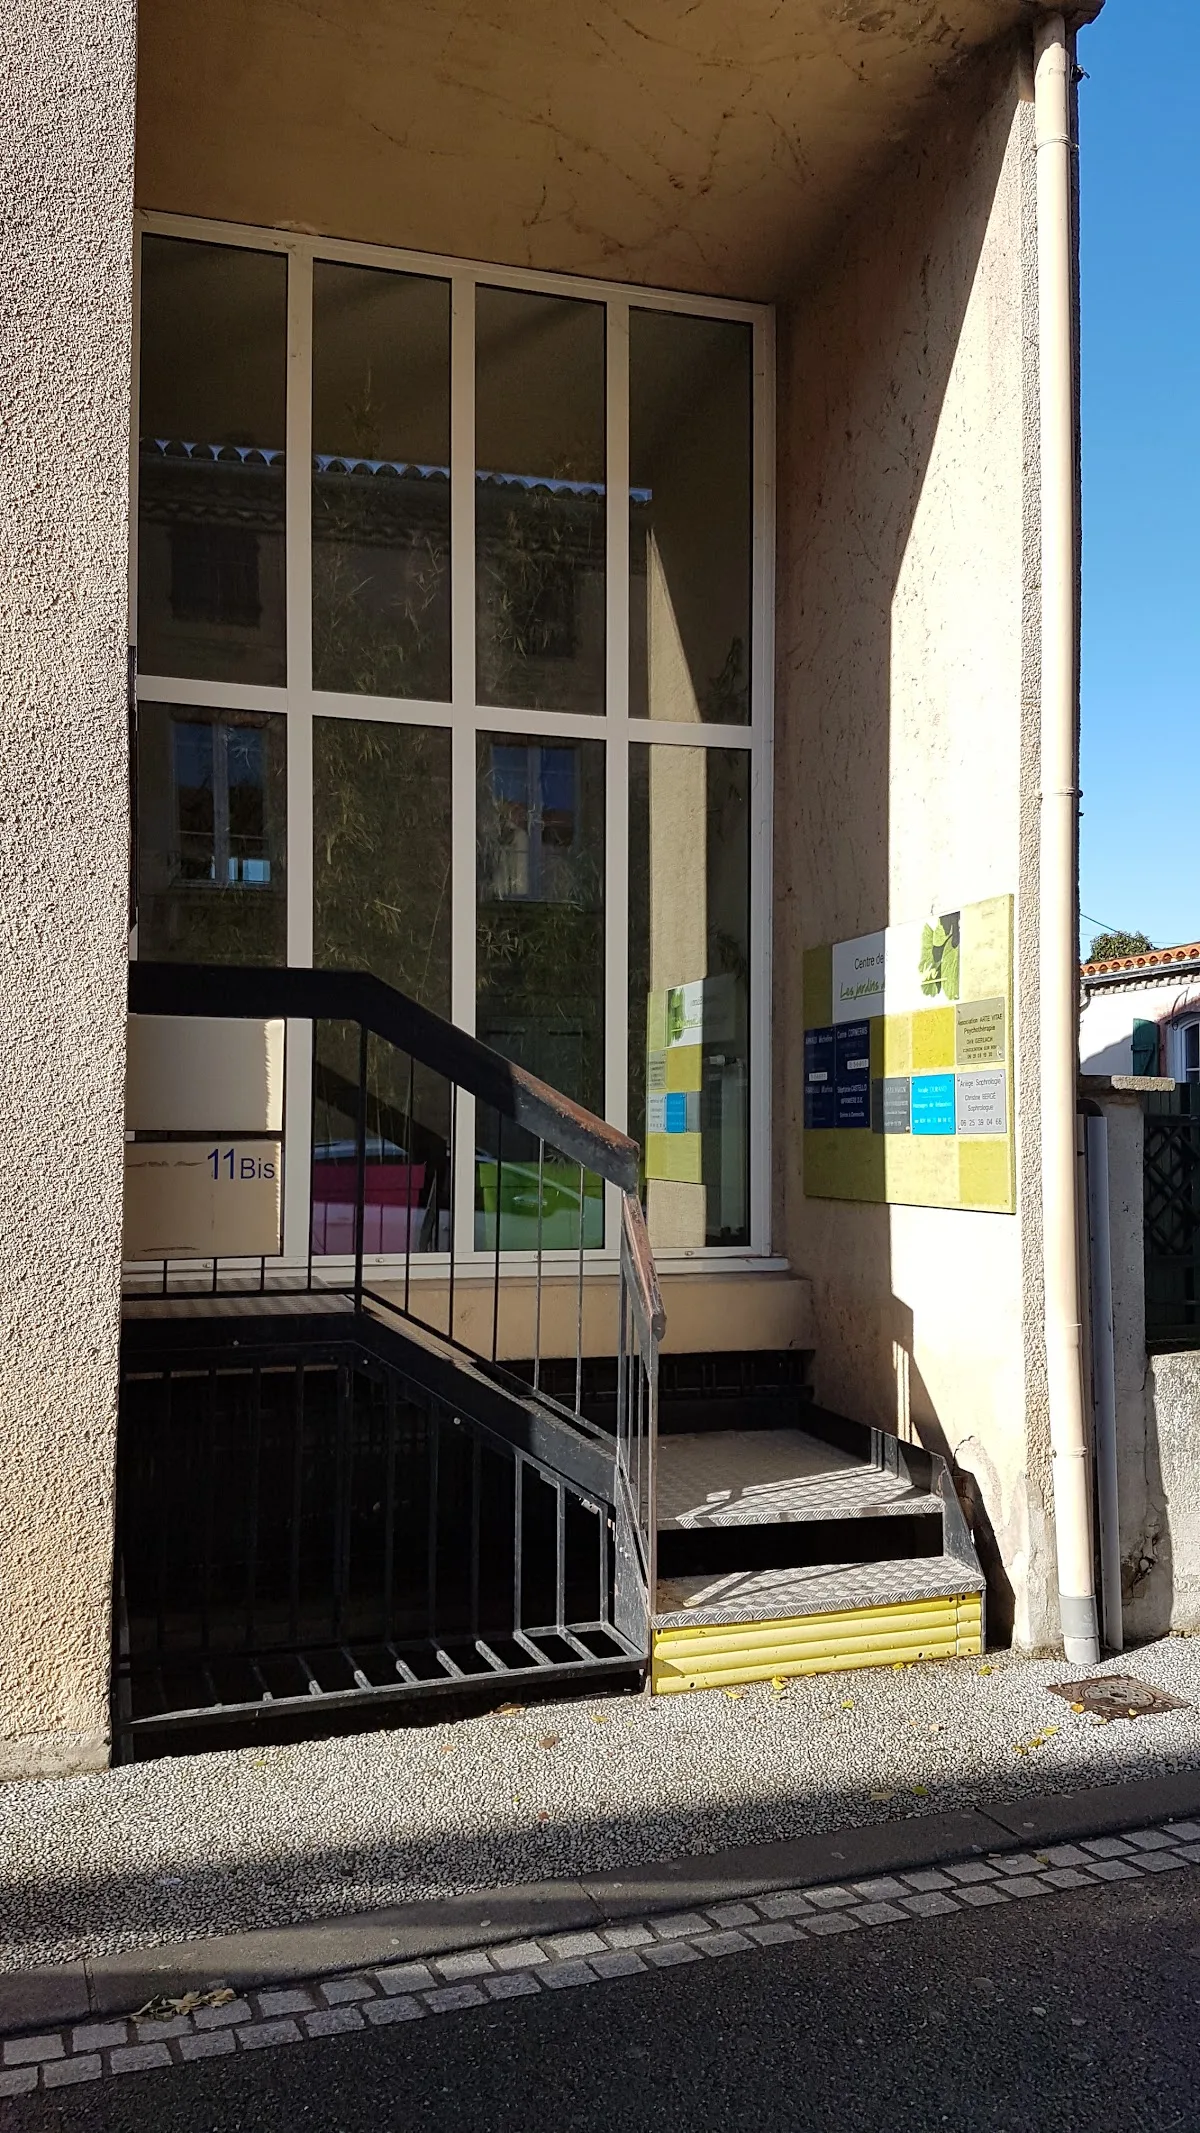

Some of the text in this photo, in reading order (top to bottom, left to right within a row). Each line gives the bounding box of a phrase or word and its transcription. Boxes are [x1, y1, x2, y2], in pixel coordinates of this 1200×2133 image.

[854, 956, 875, 970] Centre
[876, 953, 884, 964] de
[840, 983, 854, 998] Les
[855, 978, 879, 1000] jardins
[976, 1078, 1001, 1087] Sophrologie
[967, 1104, 994, 1113] Sophrologue
[969, 1119, 976, 1127] 25
[987, 1118, 993, 1126] 04
